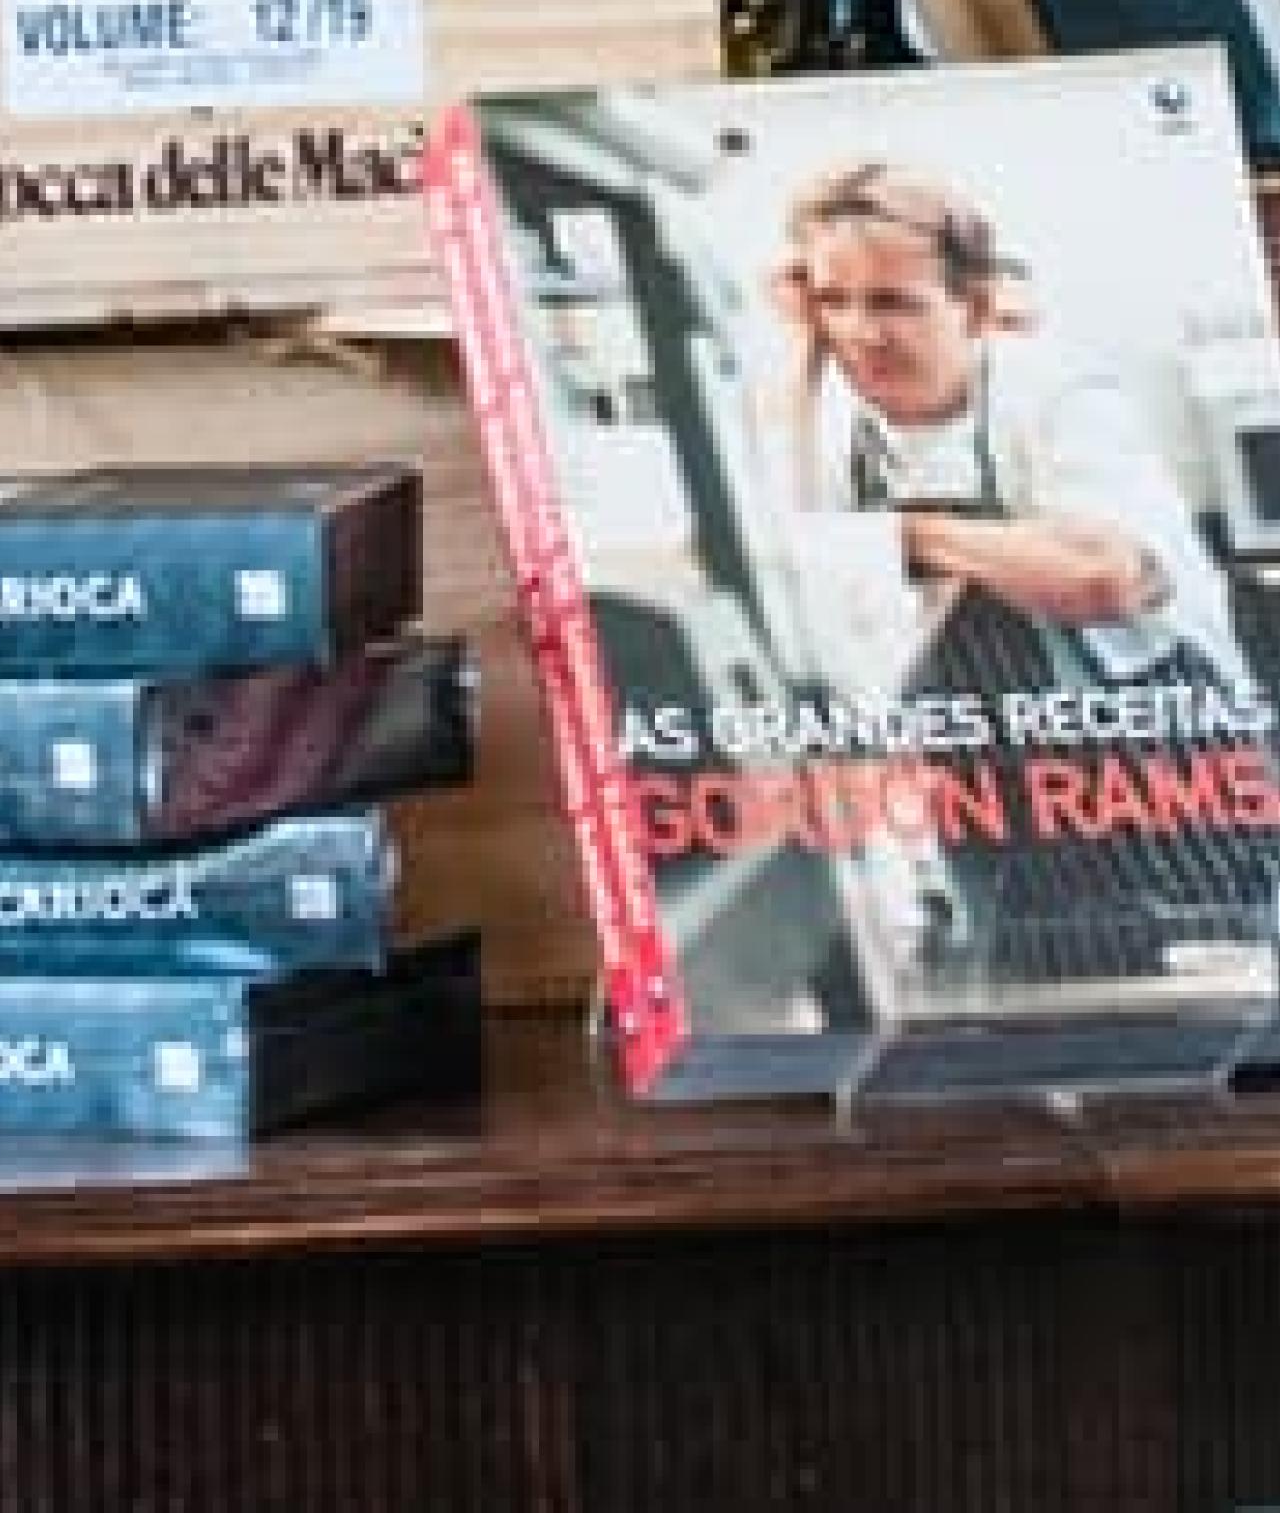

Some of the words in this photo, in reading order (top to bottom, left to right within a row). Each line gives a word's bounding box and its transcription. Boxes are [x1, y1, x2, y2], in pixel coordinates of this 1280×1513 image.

[145, 135, 286, 211] delle
[622, 706, 699, 758] AS
[711, 699, 989, 758] GRANDES
[1008, 684, 1272, 750] RECEITAS
[631, 756, 1008, 856] GORDON
